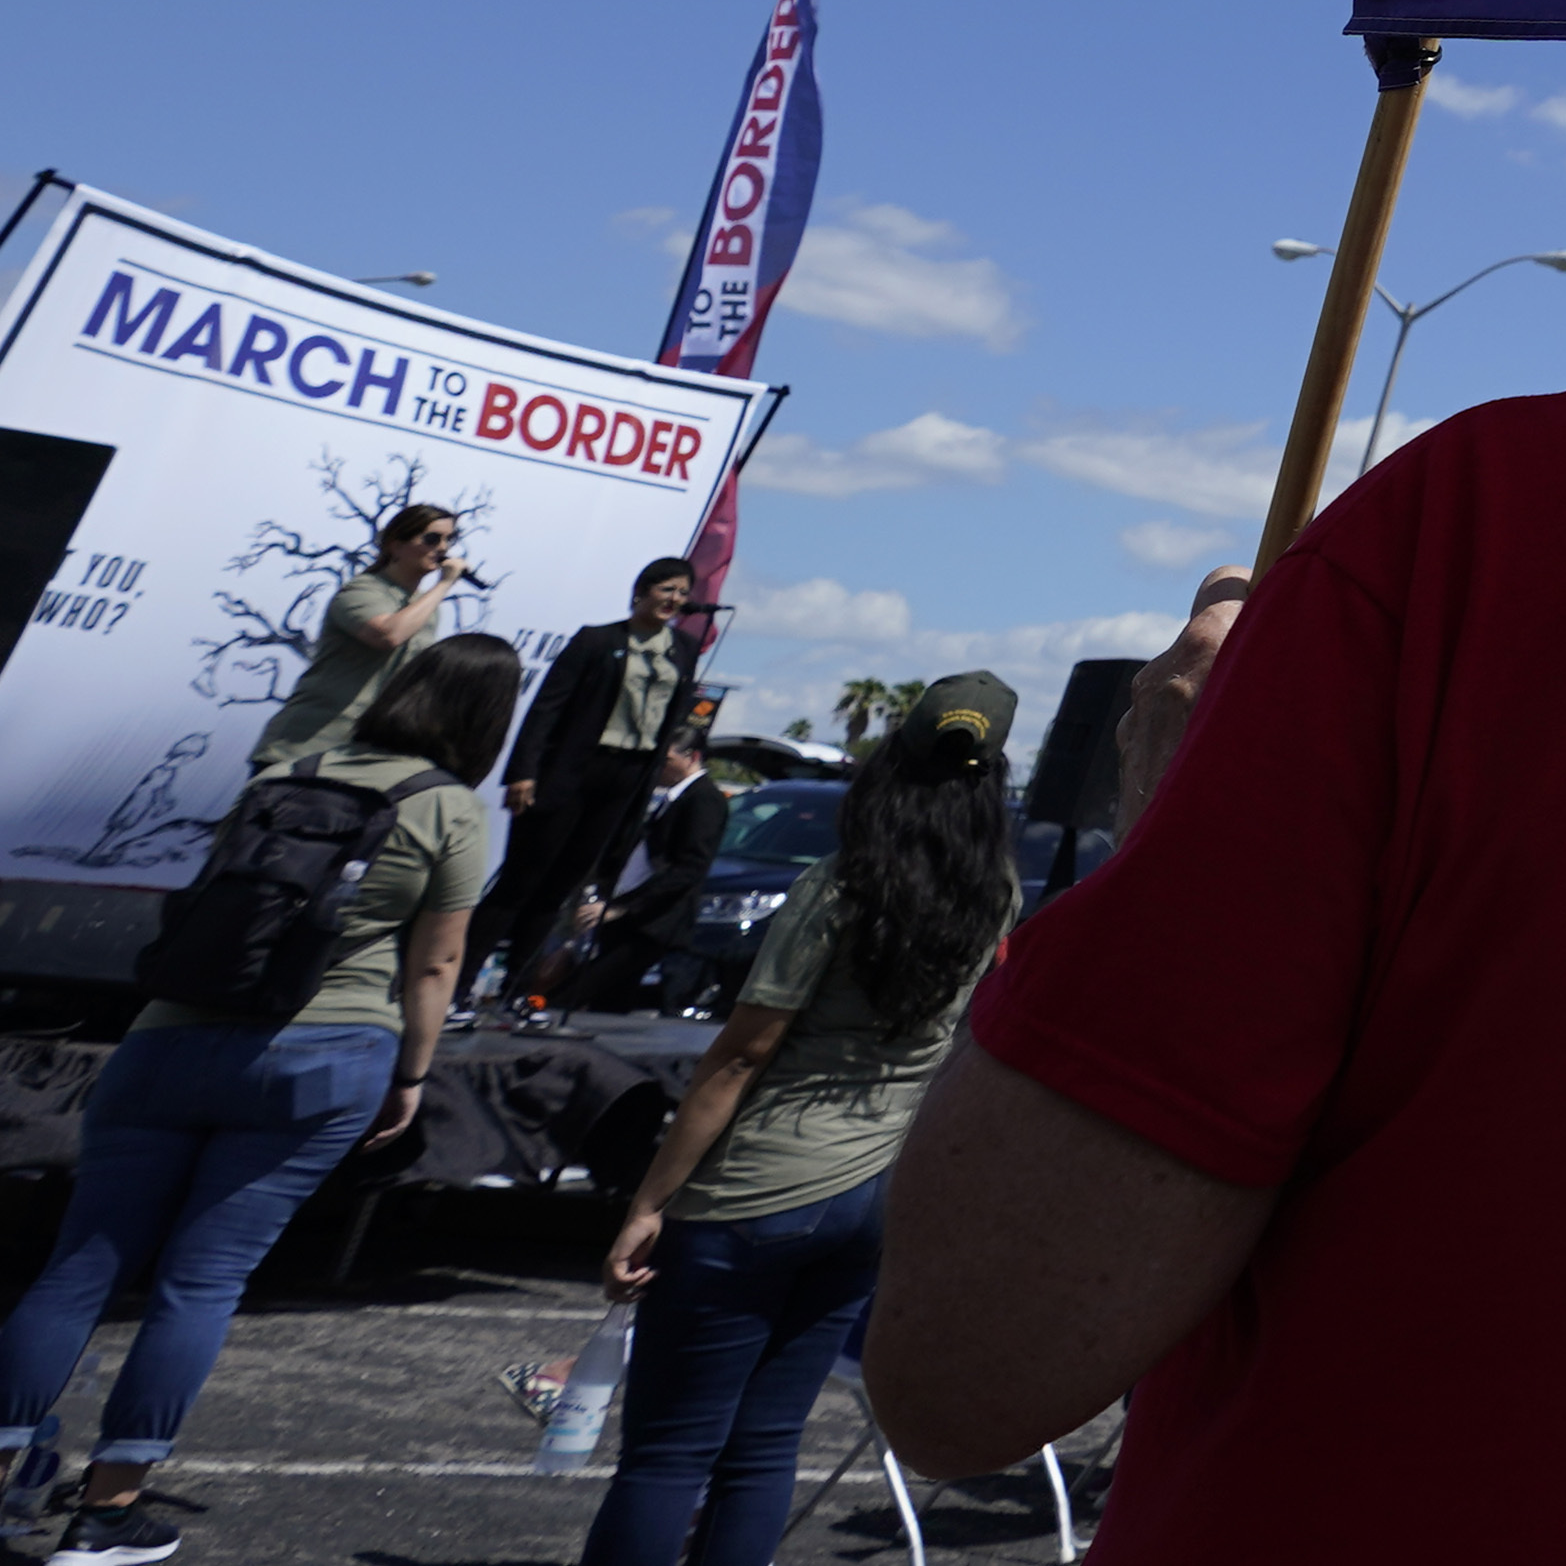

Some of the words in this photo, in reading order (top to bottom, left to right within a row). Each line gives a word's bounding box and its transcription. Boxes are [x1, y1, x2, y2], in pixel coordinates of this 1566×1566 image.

[686, 287, 714, 335] TO
[718, 280, 750, 342] THE
[80, 270, 409, 416] MARCH
[429, 365, 467, 396] TO
[412, 397, 468, 433] THE
[475, 382, 702, 482] BORDER
[79, 553, 148, 598] YOU,
[33, 589, 130, 635] WHO?
